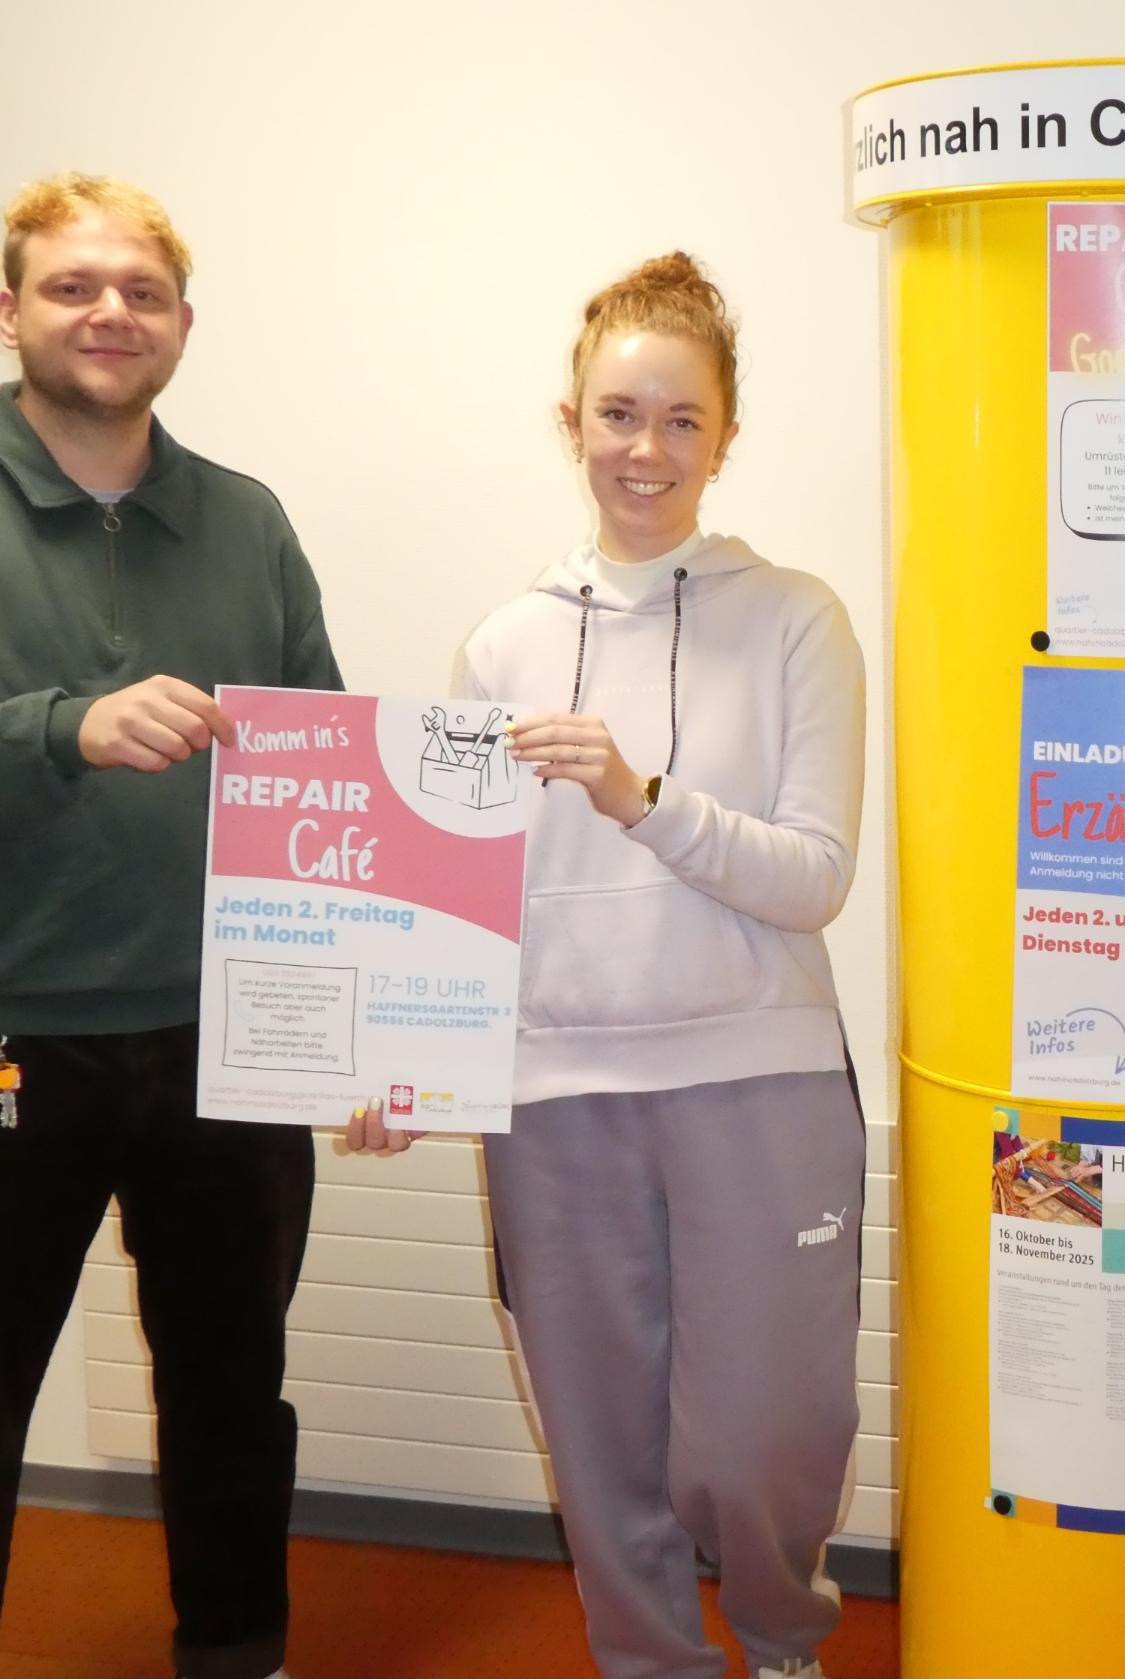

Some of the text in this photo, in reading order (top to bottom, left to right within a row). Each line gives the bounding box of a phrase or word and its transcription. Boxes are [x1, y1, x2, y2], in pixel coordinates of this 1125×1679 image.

[920, 106, 999, 158] nah
[1021, 102, 1067, 149] in
[235, 719, 310, 754] Komm
[221, 773, 371, 813] REPAIR
[288, 818, 379, 882] Café
[1030, 850, 1098, 865] Willkommen
[1099, 854, 1124, 867] sind
[1029, 865, 1094, 881] Anmeldung
[1095, 868, 1124, 881] nicht
[214, 896, 416, 931] Jeden 2. Freitag
[1022, 906, 1089, 925] Jeden
[1092, 909, 1111, 927] 2.
[214, 919, 337, 947] im Monat
[1022, 933, 1120, 961] Dienstag
[368, 974, 487, 1000] 17-19 UHR
[1026, 1018, 1096, 1038] Weitere
[1029, 1039, 1076, 1055] Infos
[797, 1223, 838, 1248] PUMA
[998, 1228, 1074, 1249] 16. Oktober bis
[998, 1242, 1095, 1266] 18. November 2025
[996, 1268, 1053, 1286] Veranstaltungen
[1052, 1275, 1070, 1288] rund
[1070, 1280, 1083, 1290] um
[1083, 1278, 1098, 1291] den
[1098, 1280, 1113, 1294] Tag
[1112, 1281, 1125, 1292] der
